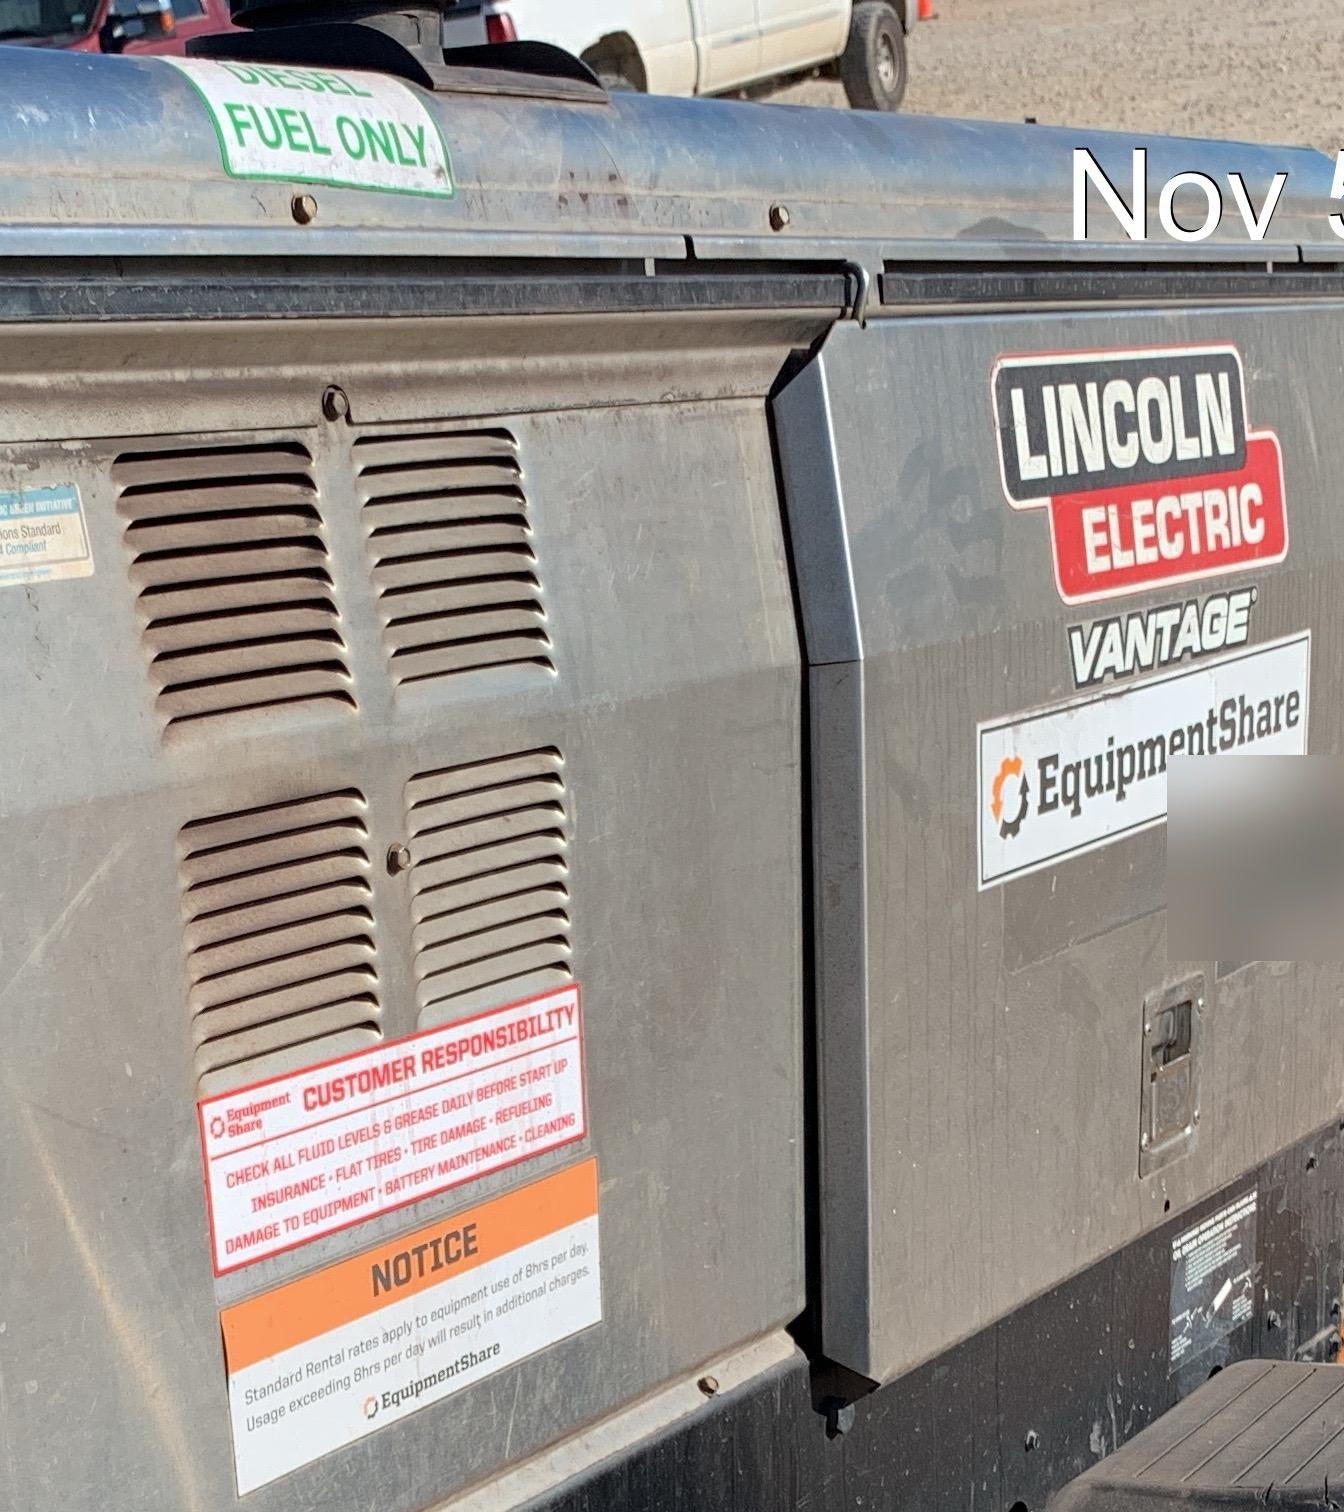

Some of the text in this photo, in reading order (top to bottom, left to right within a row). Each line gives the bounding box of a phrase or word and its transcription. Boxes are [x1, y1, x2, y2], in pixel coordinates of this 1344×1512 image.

[218, 62, 373, 98] DIESEL
[223, 103, 428, 168] FUEL ONLY
[1010, 372, 1236, 480] LINCOLN
[6, 540, 47, 556] Compliant
[21, 521, 62, 540] Standard
[1081, 482, 1266, 575] ELECTRIC
[1069, 591, 1253, 684] VANTAGE
[1037, 688, 1301, 818] EquipmentShare
[303, 1003, 575, 1113] CUSTOMER RESPONSIBILITY
[225, 1058, 569, 1189] CHECK ALL FLUID LEVELS & GREASE DAILY BEFORE START UP
[226, 1091, 292, 1124] Equipment
[227, 1117, 263, 1138] Share
[251, 1092, 554, 1214] INSURANCE FLAT TIRES TIRE DAMAGE REFUELING
[224, 1111, 576, 1256] DAMAGE TO EQUIPMENT BATTERY MAINTENANCE CLEANING
[370, 1222, 479, 1298] NOTICE
[244, 1238, 590, 1407] Standard Rental rates apply to equipment use of 8hrs per day.
[246, 1264, 591, 1434] Usage exceeding 8hrs per day will result in additional charges.
[380, 1339, 502, 1411] EquipmentShare
